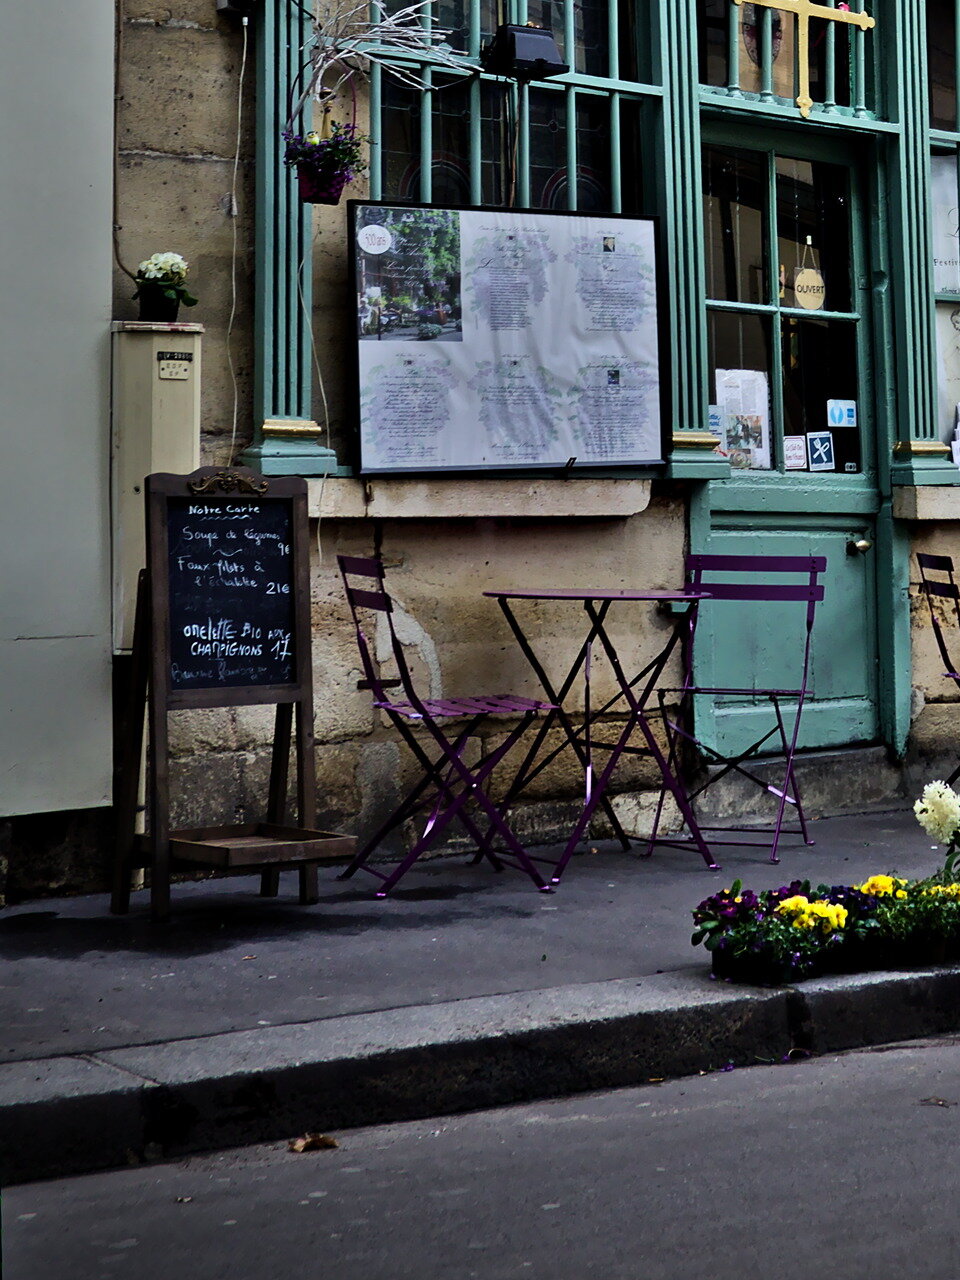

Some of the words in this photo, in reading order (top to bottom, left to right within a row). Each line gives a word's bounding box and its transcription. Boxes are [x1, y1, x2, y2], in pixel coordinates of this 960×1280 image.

[796, 284, 825, 294] OUVERT
[188, 504, 222, 515] Notre
[225, 503, 260, 514] Carte
[182, 525, 219, 548] Soupe
[225, 529, 237, 539] de
[243, 528, 281, 546] légumes
[277, 542, 290, 556] 9€
[254, 560, 265, 572] à
[265, 581, 290, 595] 21€
